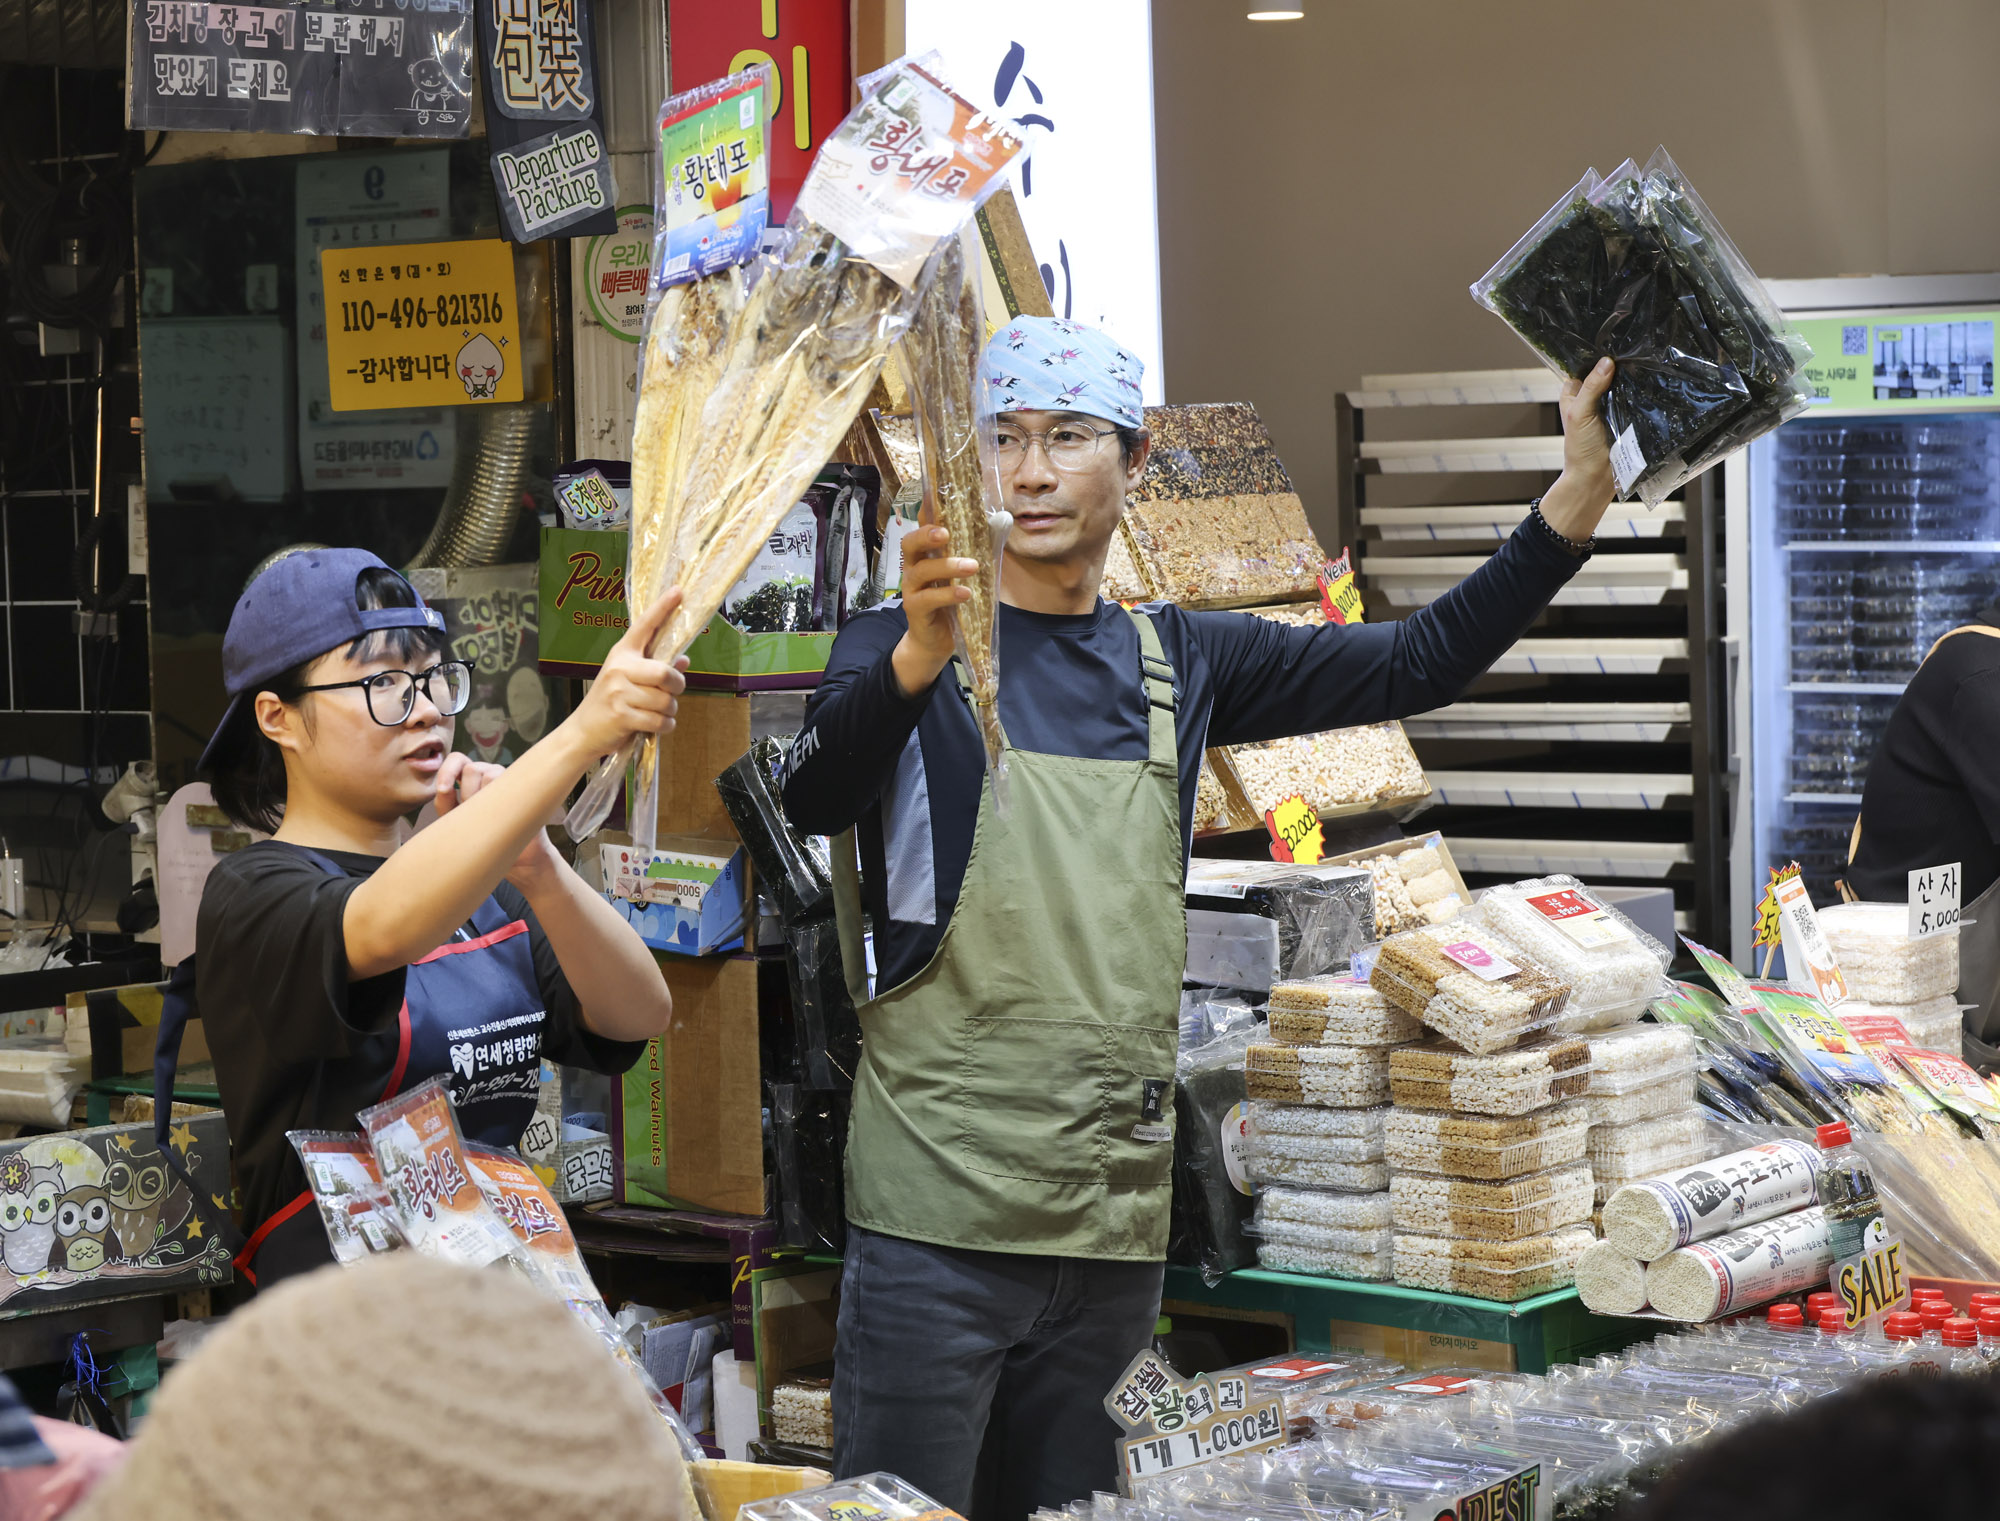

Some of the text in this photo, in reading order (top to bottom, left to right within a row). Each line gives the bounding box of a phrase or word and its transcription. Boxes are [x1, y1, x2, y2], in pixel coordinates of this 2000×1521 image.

[146, 5, 401, 56] 김치냉장고에 보관해서
[156, 56, 290, 100] 맛있게 드세요
[500, 133, 598, 191] Departure
[685, 140, 750, 200] 황태포
[517, 173, 601, 224] Packing
[342, 292, 503, 331] 110-496-821316
[567, 477, 618, 515] 5천원
[1788, 1012, 1844, 1041] 황태포
[650, 1079, 662, 1167] Walnuts
[404, 1150, 467, 1220] 황태포
[1841, 1246, 1904, 1322] SALE
[1454, 1337, 1479, 1350] 마시오
[1129, 1406, 1280, 1474] 1개 1.000원
